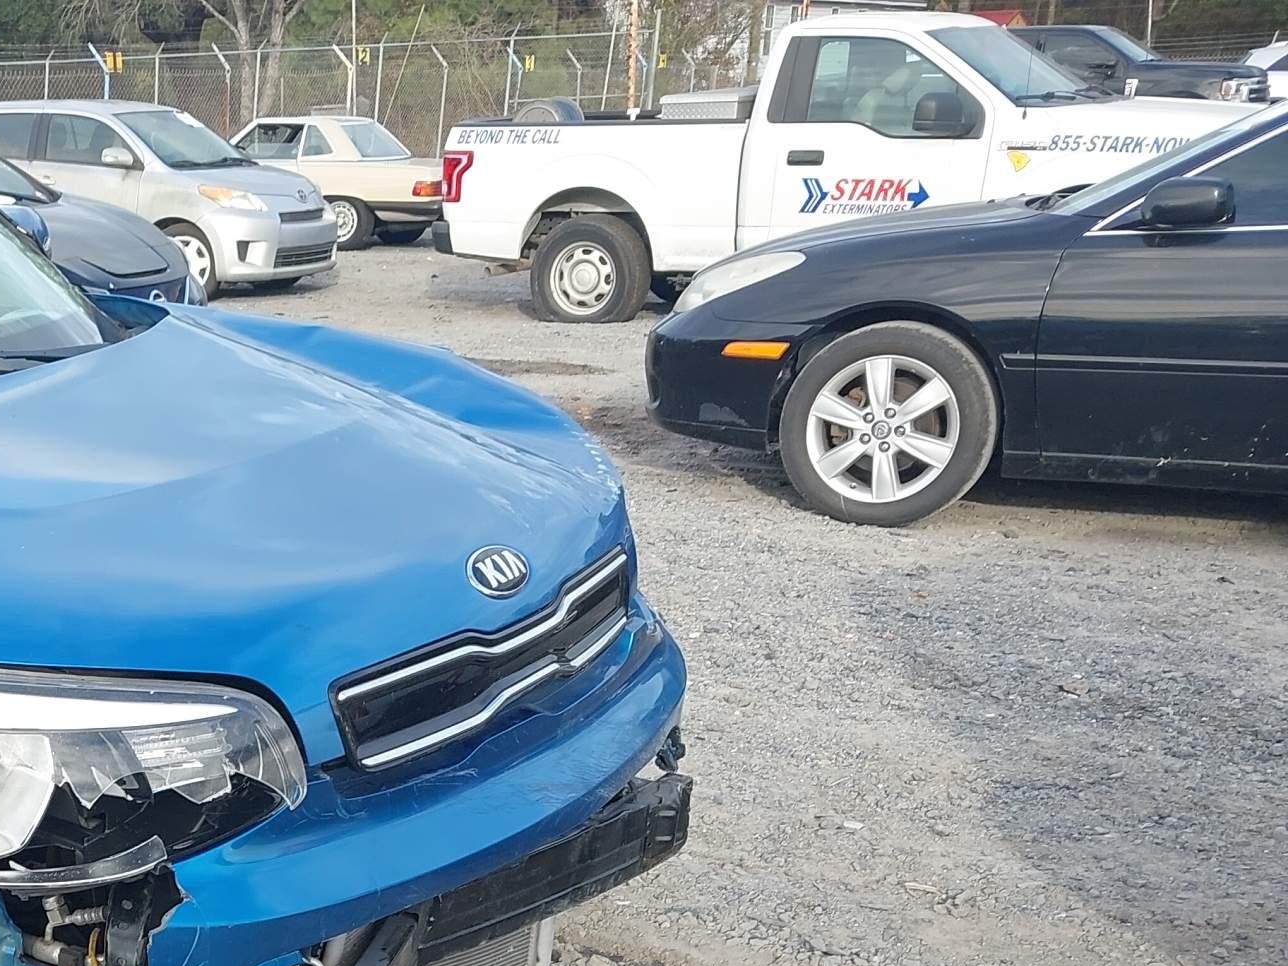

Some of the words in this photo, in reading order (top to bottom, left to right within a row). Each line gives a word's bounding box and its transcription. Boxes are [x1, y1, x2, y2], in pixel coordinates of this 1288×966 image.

[457, 129, 503, 145] BEYOND
[505, 129, 529, 144] THE
[531, 128, 561, 144] CALL
[830, 177, 913, 202] STARK
[474, 549, 527, 589] KIA
